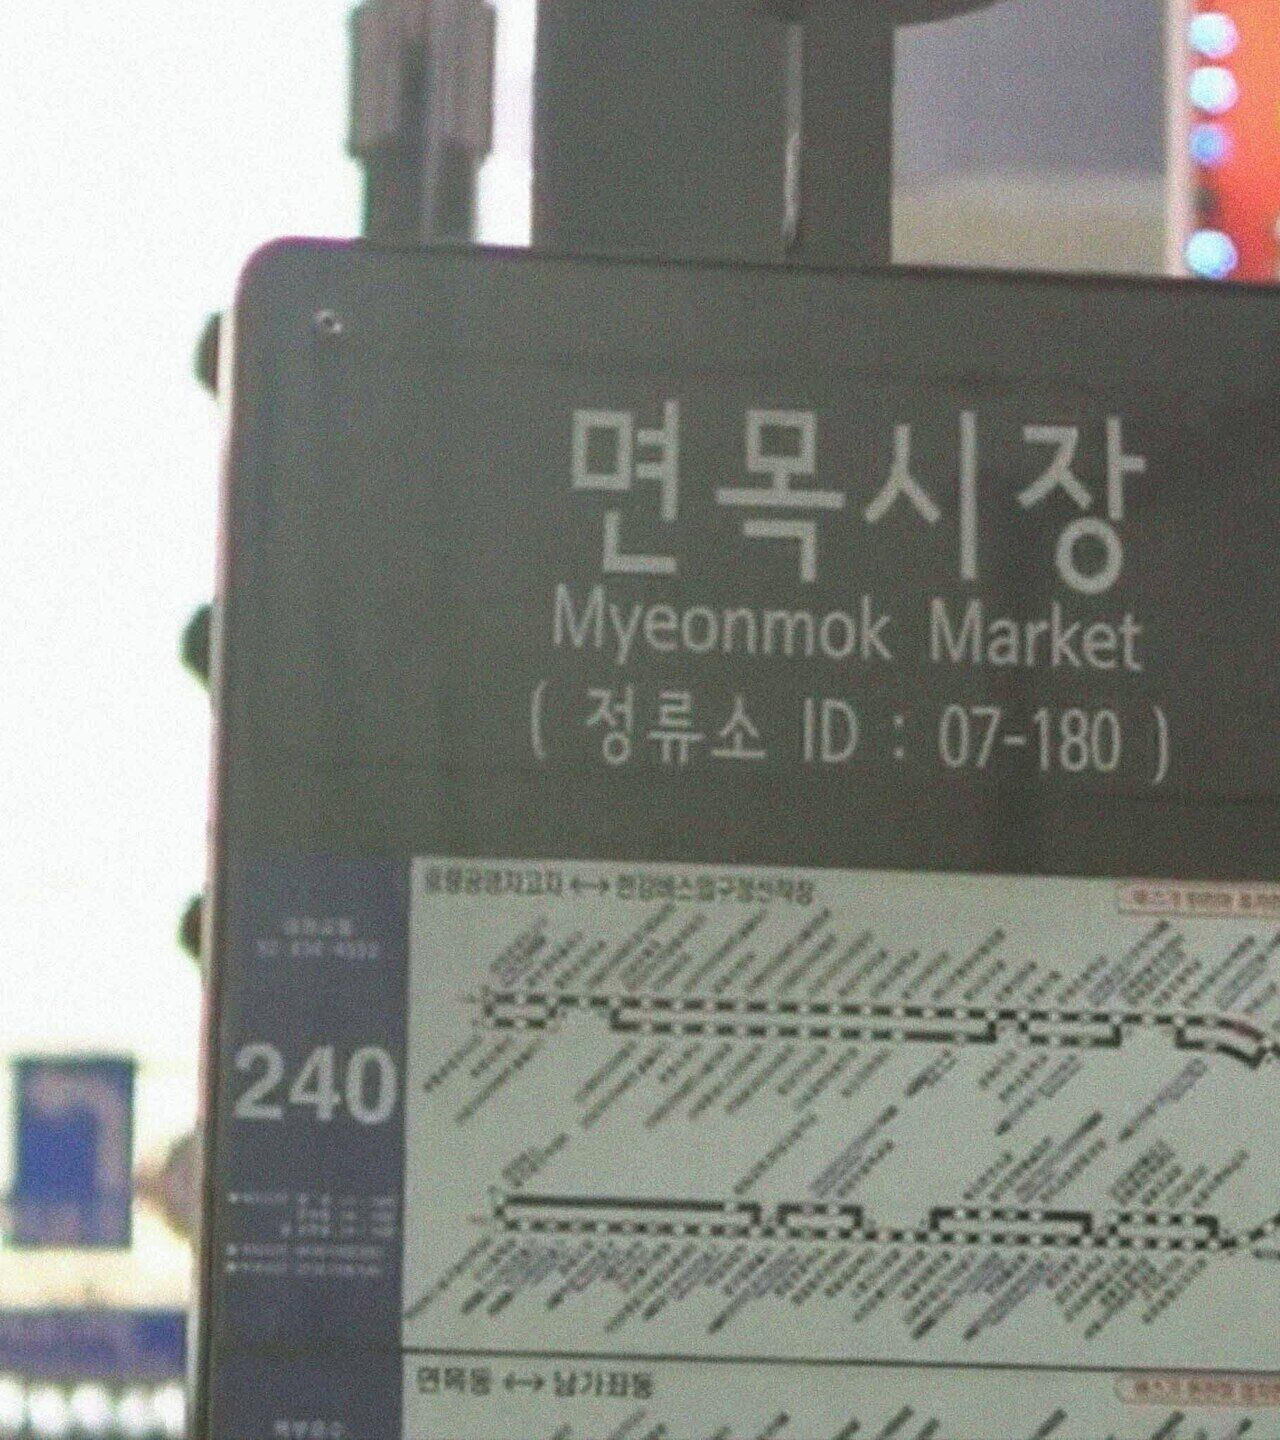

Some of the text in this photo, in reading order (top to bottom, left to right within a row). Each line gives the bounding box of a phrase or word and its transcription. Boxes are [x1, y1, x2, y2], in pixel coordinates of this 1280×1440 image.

[570, 401, 1147, 594] 면목시장
[552, 582, 1144, 672] Myeonmok Market
[586, 685, 766, 765] 정류소
[804, 698, 859, 763] ID
[938, 703, 1122, 773] 07-180
[234, 1042, 398, 1124] 240
